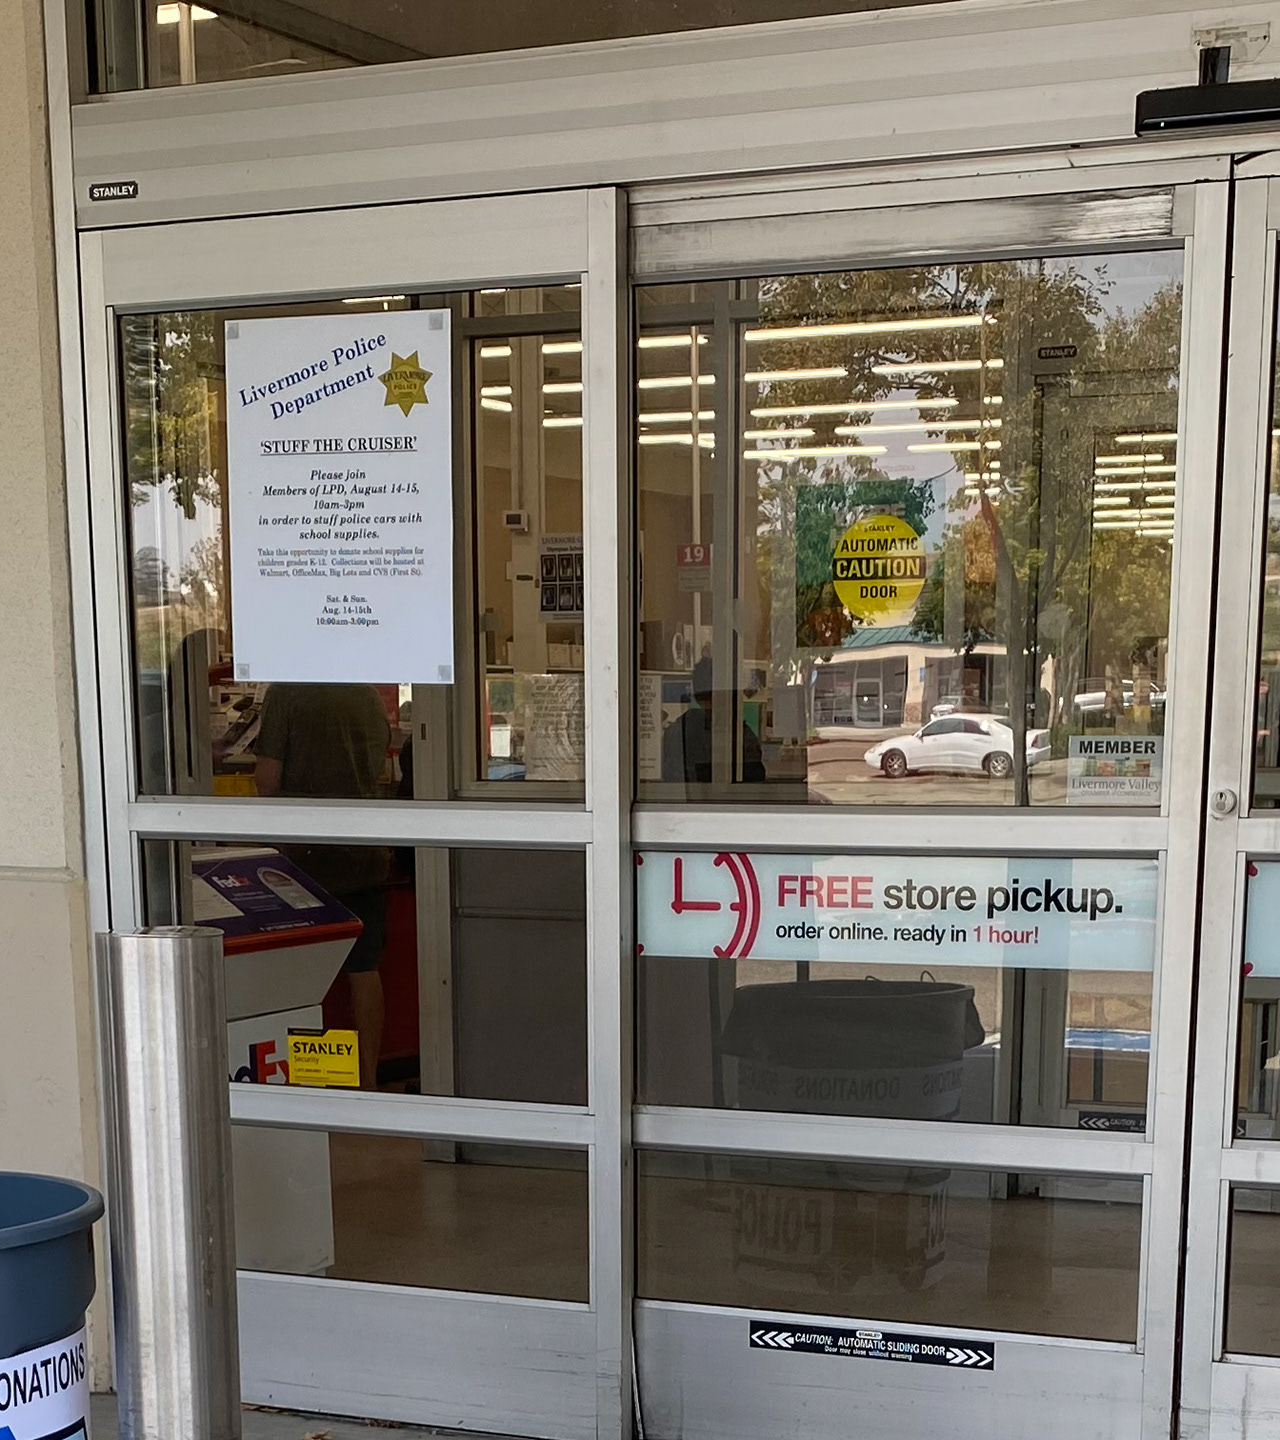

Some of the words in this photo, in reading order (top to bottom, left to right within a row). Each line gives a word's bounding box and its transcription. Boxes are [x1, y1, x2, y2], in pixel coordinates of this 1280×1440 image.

[93, 185, 134, 197] STANLEY
[238, 358, 329, 408] Livermore
[331, 334, 387, 367] Police
[270, 364, 375, 420] Department
[313, 438, 343, 452] THE
[310, 470, 343, 480] Please
[345, 469, 366, 481] join
[263, 485, 307, 496] Members
[310, 485, 321, 497] of
[322, 484, 348, 496] LPD,
[350, 484, 387, 496] August
[391, 483, 419, 494] 14-15,
[313, 500, 365, 511] 10am-3pm
[259, 516, 269, 525] in
[272, 515, 299, 525] order
[301, 515, 311, 524] to
[313, 514, 339, 527] stuff
[339, 513, 370, 526] police
[374, 515, 396, 523] cars
[399, 512, 422, 523] with
[299, 529, 331, 539] school
[334, 529, 379, 541] supplies.
[840, 537, 918, 553] AUTOMATIC
[683, 546, 704, 563] 19
[836, 558, 920, 578] CAUTION
[860, 585, 898, 599] DOOR
[1079, 740, 1156, 754] MEMBER
[1072, 779, 1126, 789] Livermore
[1128, 779, 1159, 792] Valley
[778, 874, 874, 909] FREE
[883, 879, 977, 911] store
[987, 879, 1123, 921] pickup.
[775, 923, 825, 941] order
[828, 924, 888, 942] online.
[893, 926, 945, 946] ready
[950, 927, 967, 942] in
[973, 926, 984, 943] 1
[988, 926, 1039, 944] hour!
[292, 1041, 353, 1056] STANLEY
[293, 1055, 320, 1065] Security
[794, 1332, 833, 1346] CAUTION:
[838, 1337, 886, 1351] AUTOMATIC
[887, 1341, 920, 1354] SLIDING
[921, 1345, 946, 1356] DOOR
